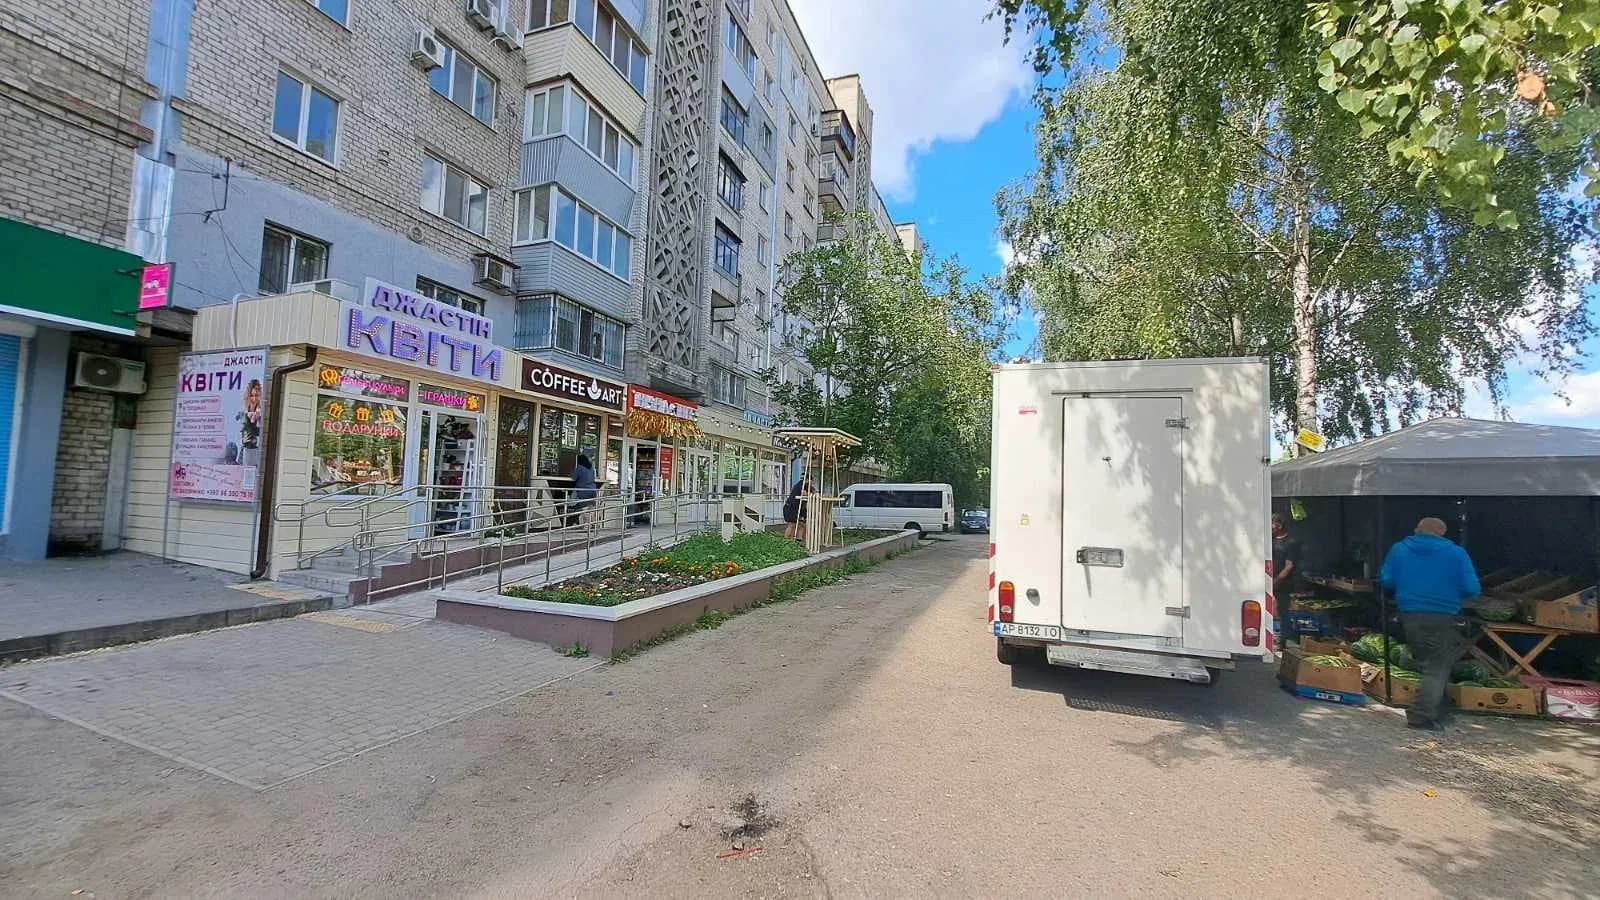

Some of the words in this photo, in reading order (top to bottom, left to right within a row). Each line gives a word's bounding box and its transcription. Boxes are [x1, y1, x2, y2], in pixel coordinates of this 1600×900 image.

[372, 285, 491, 339] ДЖАСТІН
[347, 308, 505, 381] КВІТИ
[224, 355, 263, 367] ДЖАСТІН
[181, 371, 242, 392] КВІТИ
[531, 368, 586, 397] COFFEE
[602, 388, 622, 405] ART
[424, 390, 466, 407] ІГРАШКИ
[323, 420, 399, 438] ПОДАРУНКИ
[1002, 624, 1015, 634] AP
[1018, 626, 1040, 636] 8132
